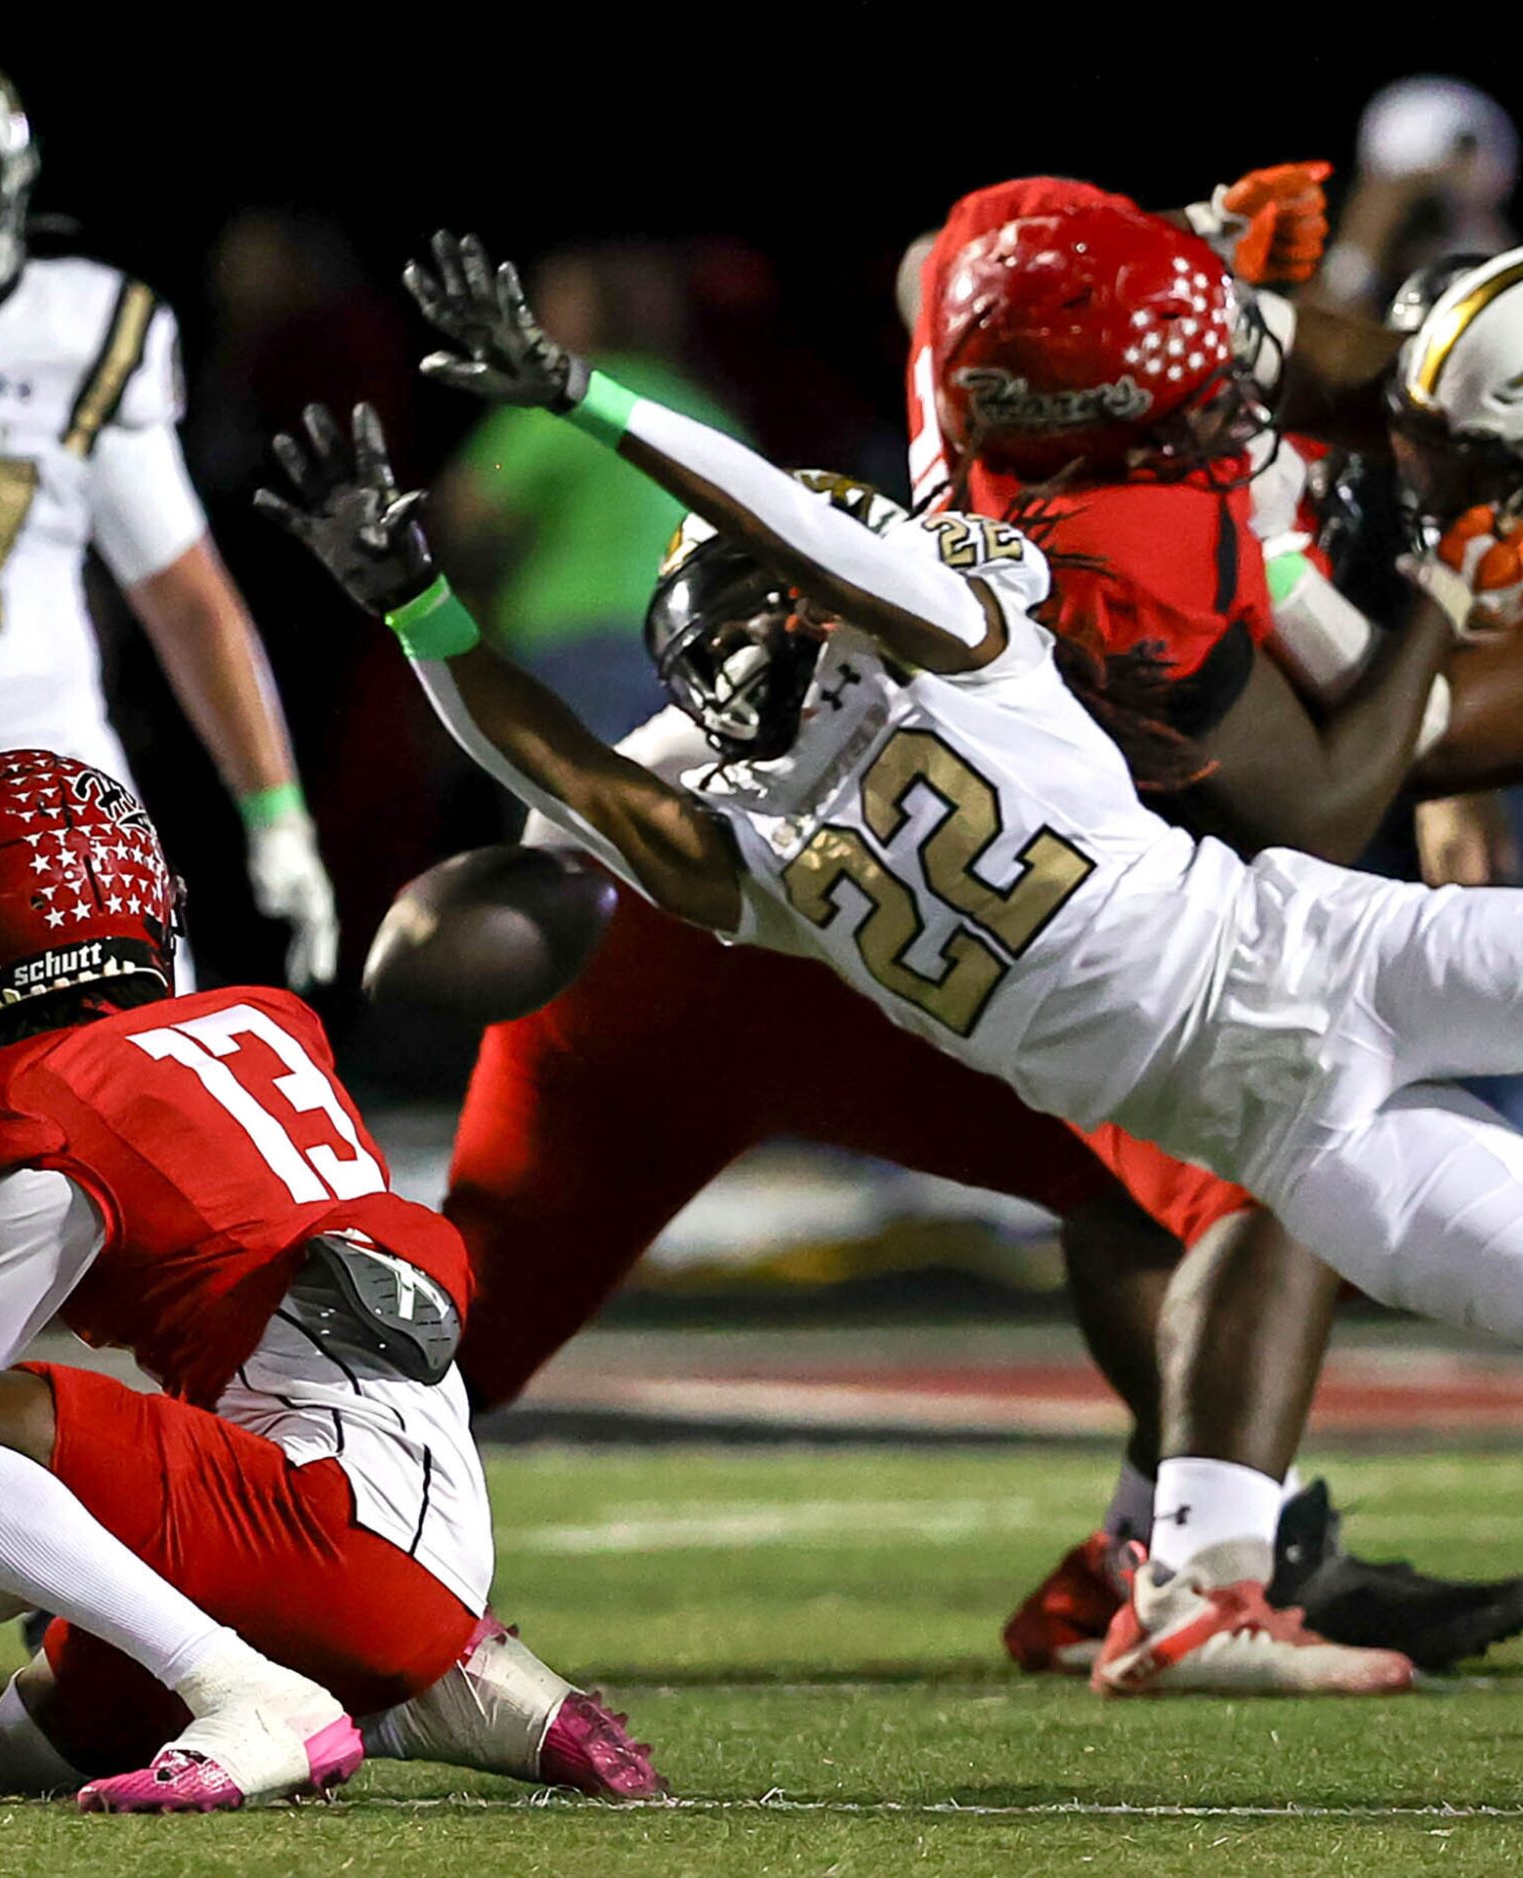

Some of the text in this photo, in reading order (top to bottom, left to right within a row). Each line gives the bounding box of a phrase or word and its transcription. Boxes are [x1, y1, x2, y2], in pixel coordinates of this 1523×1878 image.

[13, 941, 103, 987] schutt
[780, 726, 1098, 1038] 22
[125, 1003, 390, 1204] 13
